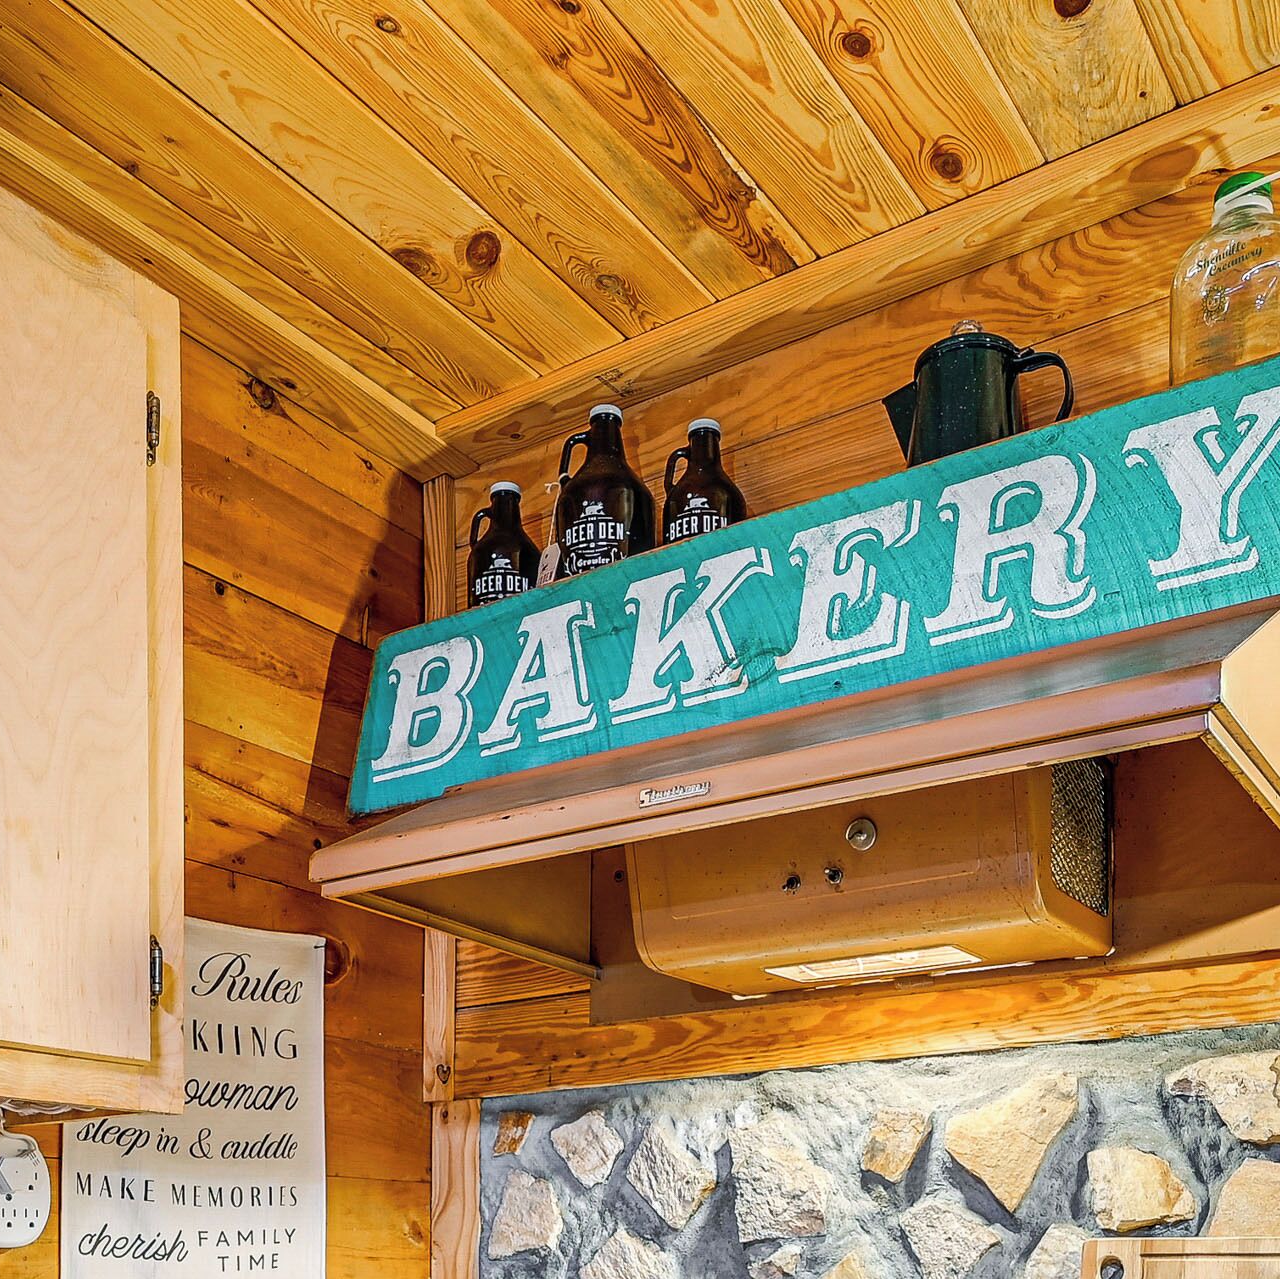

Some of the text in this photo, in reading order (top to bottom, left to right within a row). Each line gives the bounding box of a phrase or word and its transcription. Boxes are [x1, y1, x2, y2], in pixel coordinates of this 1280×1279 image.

[566, 522, 624, 546] BEER DEN
[670, 516, 699, 541] BEER
[577, 556, 610, 567] Growler
[475, 575, 503, 595] BEER
[506, 575, 529, 592] DEN
[191, 952, 304, 1004] Rules
[181, 1019, 298, 1060] KIING
[76, 1118, 298, 1159] sleep in & cuddle
[76, 1172, 298, 1207] MAKE MEMORIES
[78, 1223, 297, 1263] cherish FAMILY
[218, 1253, 280, 1272] TIME
